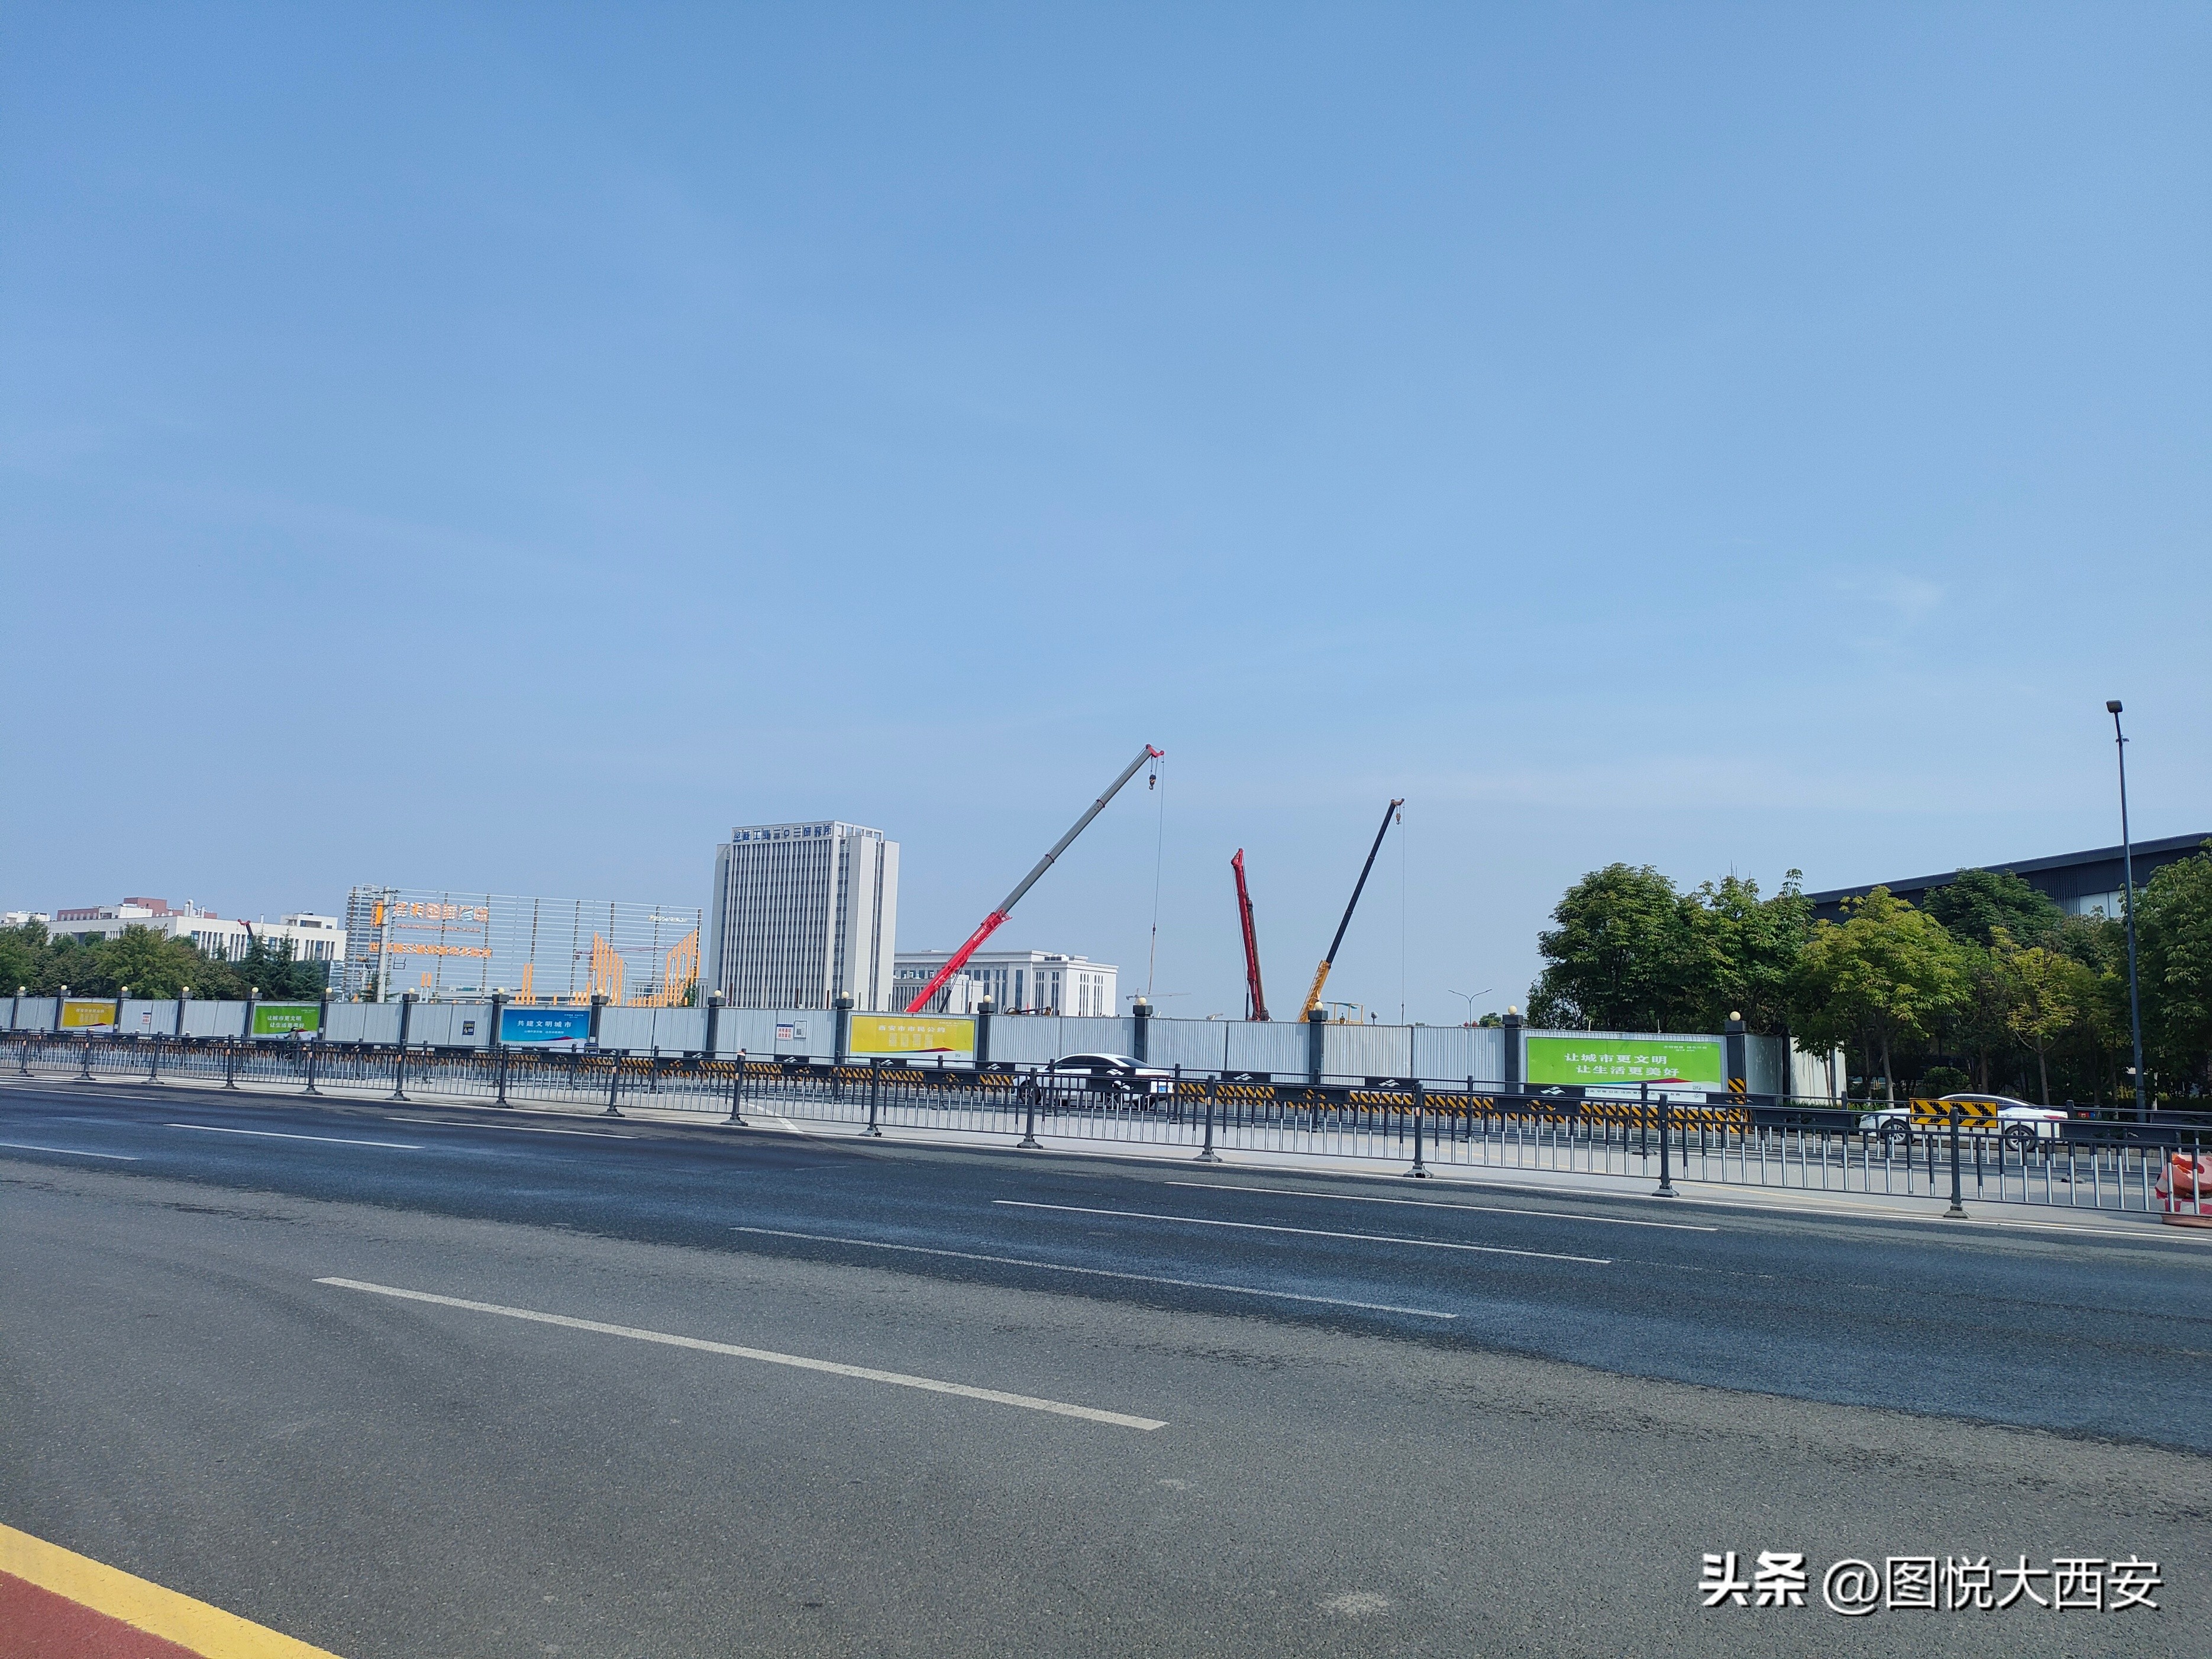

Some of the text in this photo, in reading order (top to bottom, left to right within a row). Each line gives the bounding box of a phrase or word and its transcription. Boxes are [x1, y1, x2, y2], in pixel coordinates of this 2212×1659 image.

[517, 1020, 572, 1028] 共建文明城市
[878, 1025, 946, 1033] 西安市市民公约
[1564, 1053, 1667, 1065] 让城市更文明
[1575, 1065, 1680, 1077] 让生活更美好
